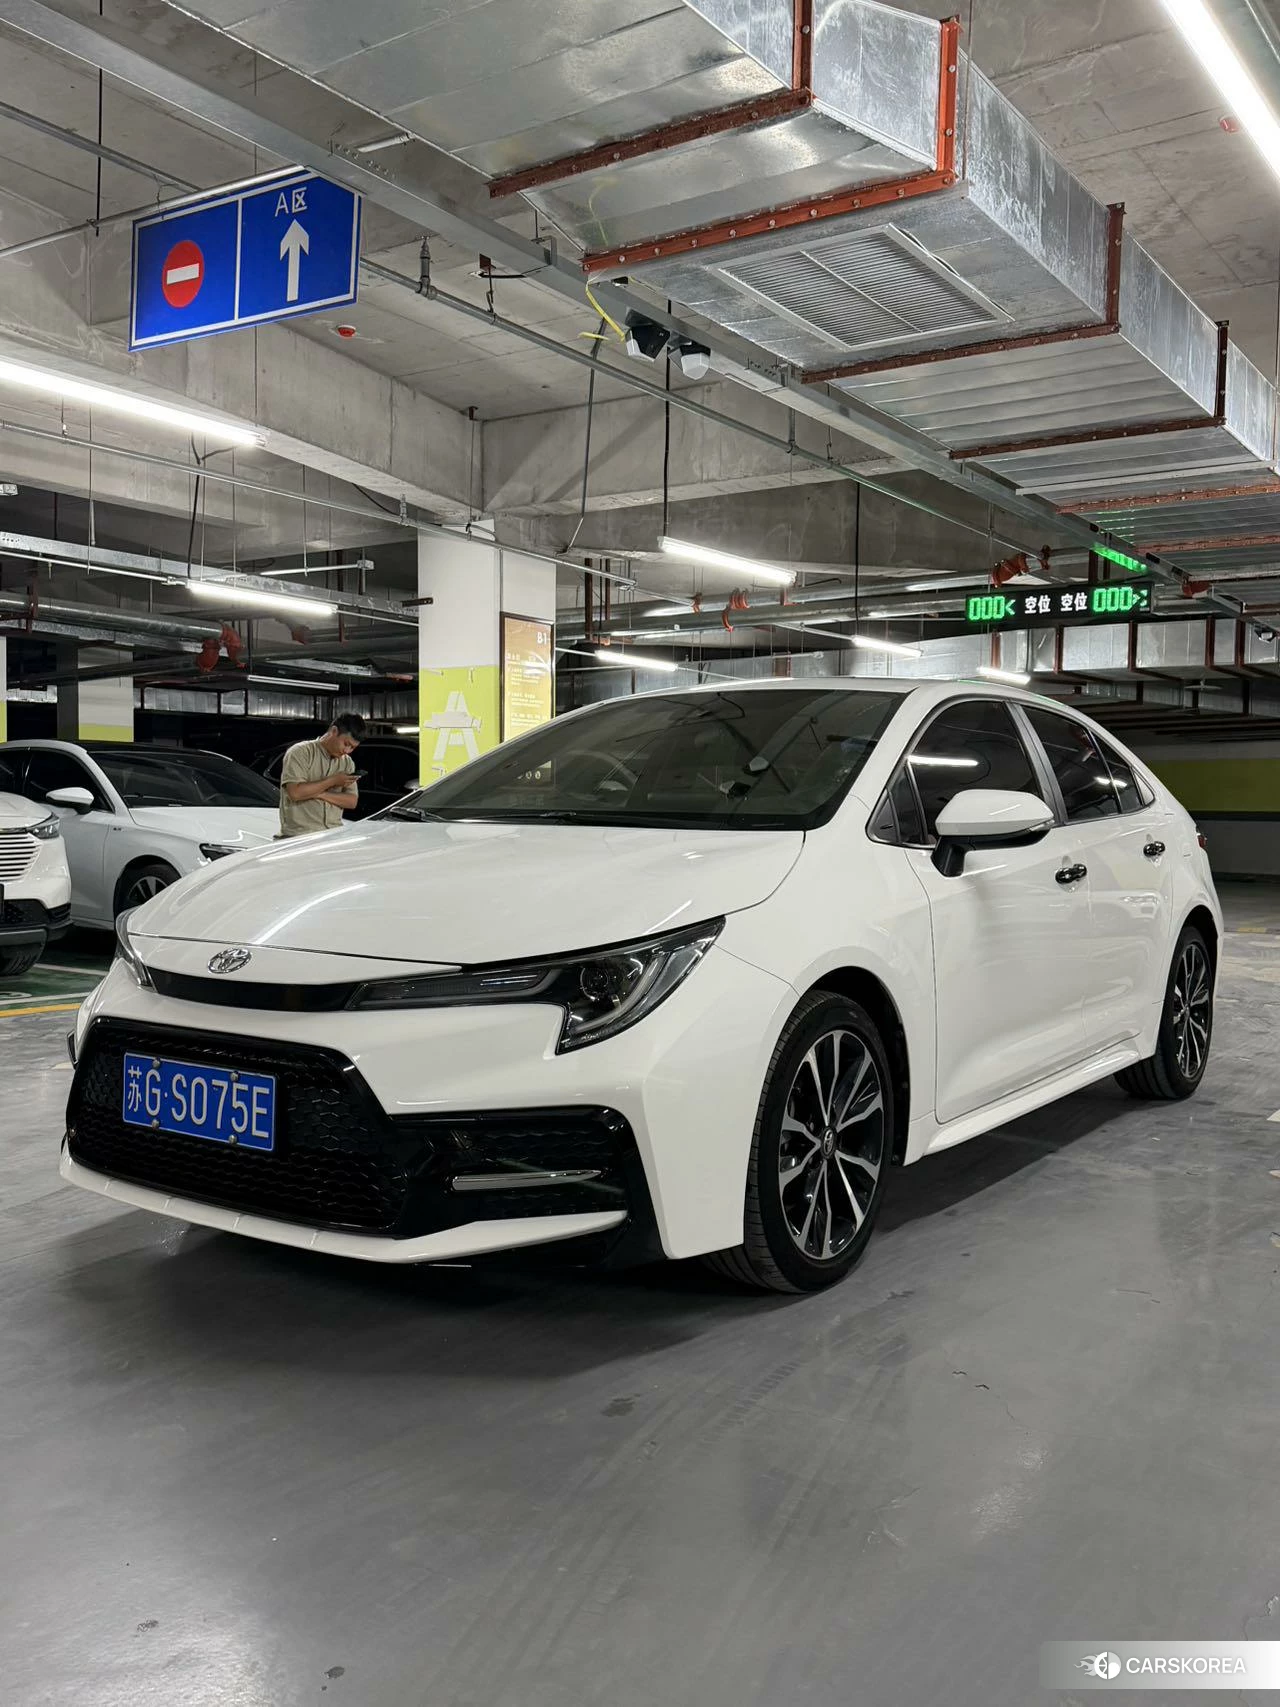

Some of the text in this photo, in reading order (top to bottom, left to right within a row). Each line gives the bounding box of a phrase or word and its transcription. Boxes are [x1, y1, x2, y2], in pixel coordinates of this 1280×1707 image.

[274, 187, 308, 217] A区
[1024, 595, 1051, 615] 空位
[1060, 592, 1088, 612] 空位
